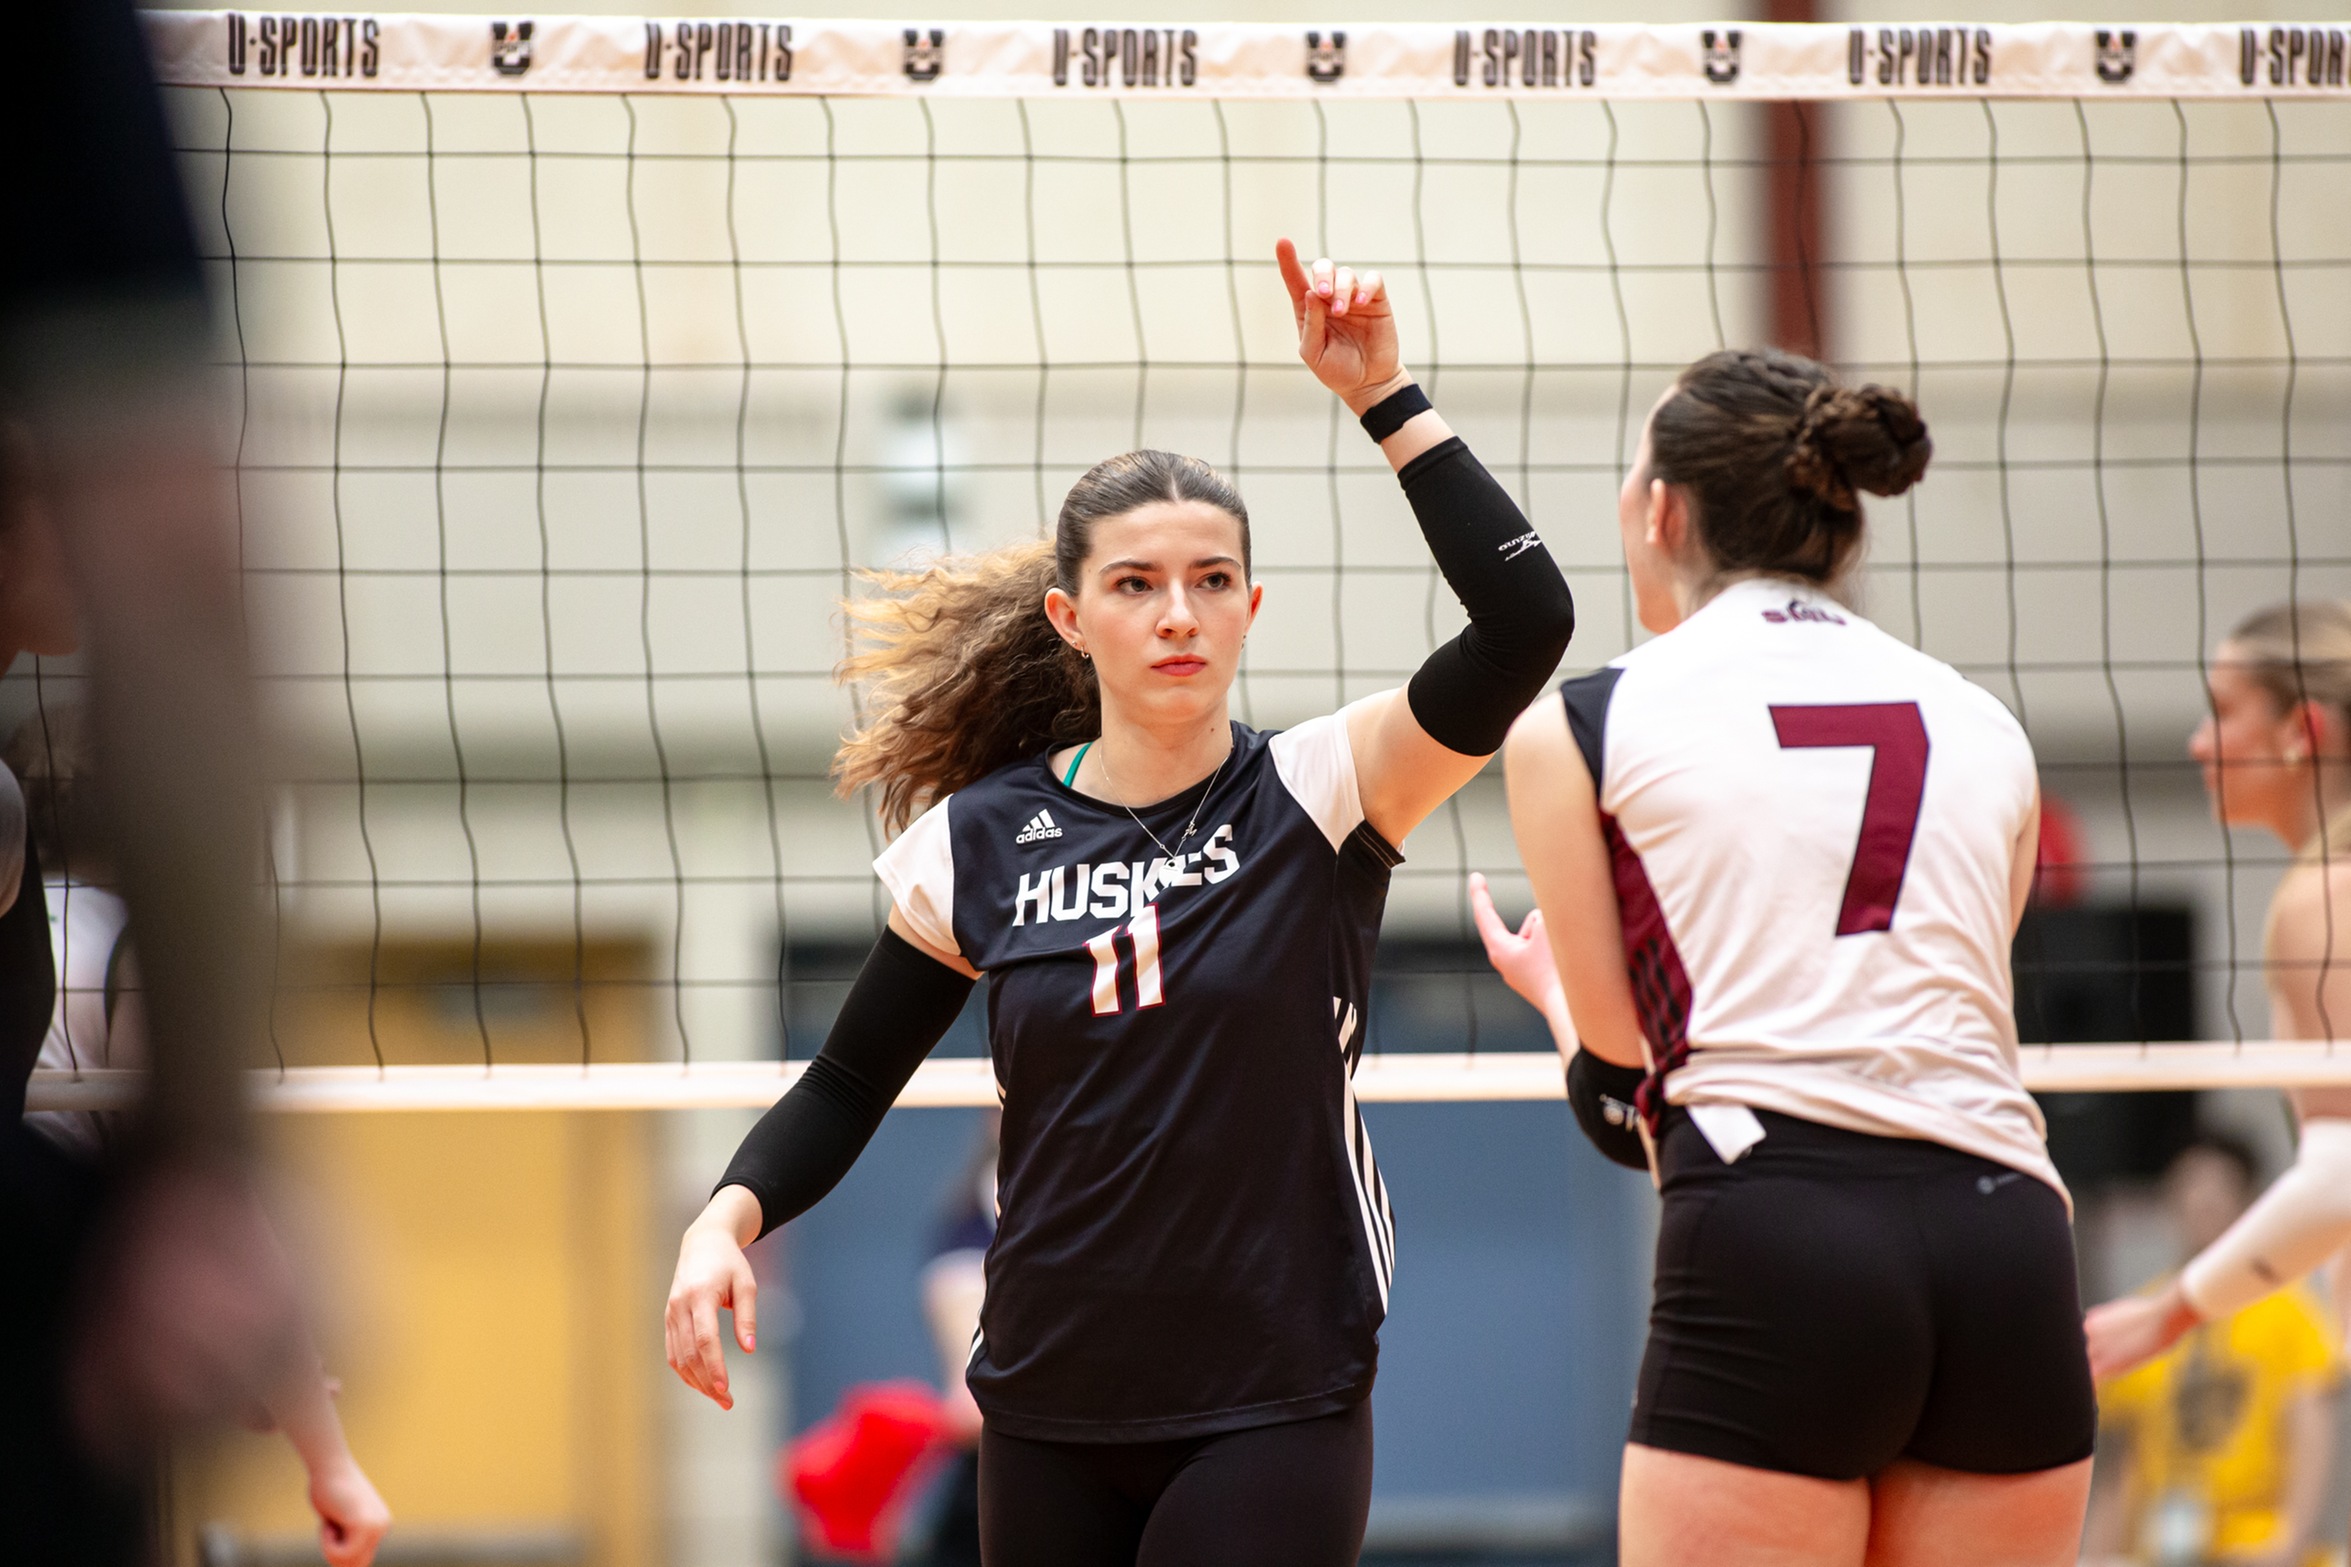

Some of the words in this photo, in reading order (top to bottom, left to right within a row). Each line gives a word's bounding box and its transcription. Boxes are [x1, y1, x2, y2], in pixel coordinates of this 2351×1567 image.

[1015, 826, 1063, 844] adidas
[1767, 701, 1930, 937] 7
[1082, 902, 1166, 1018] 11
